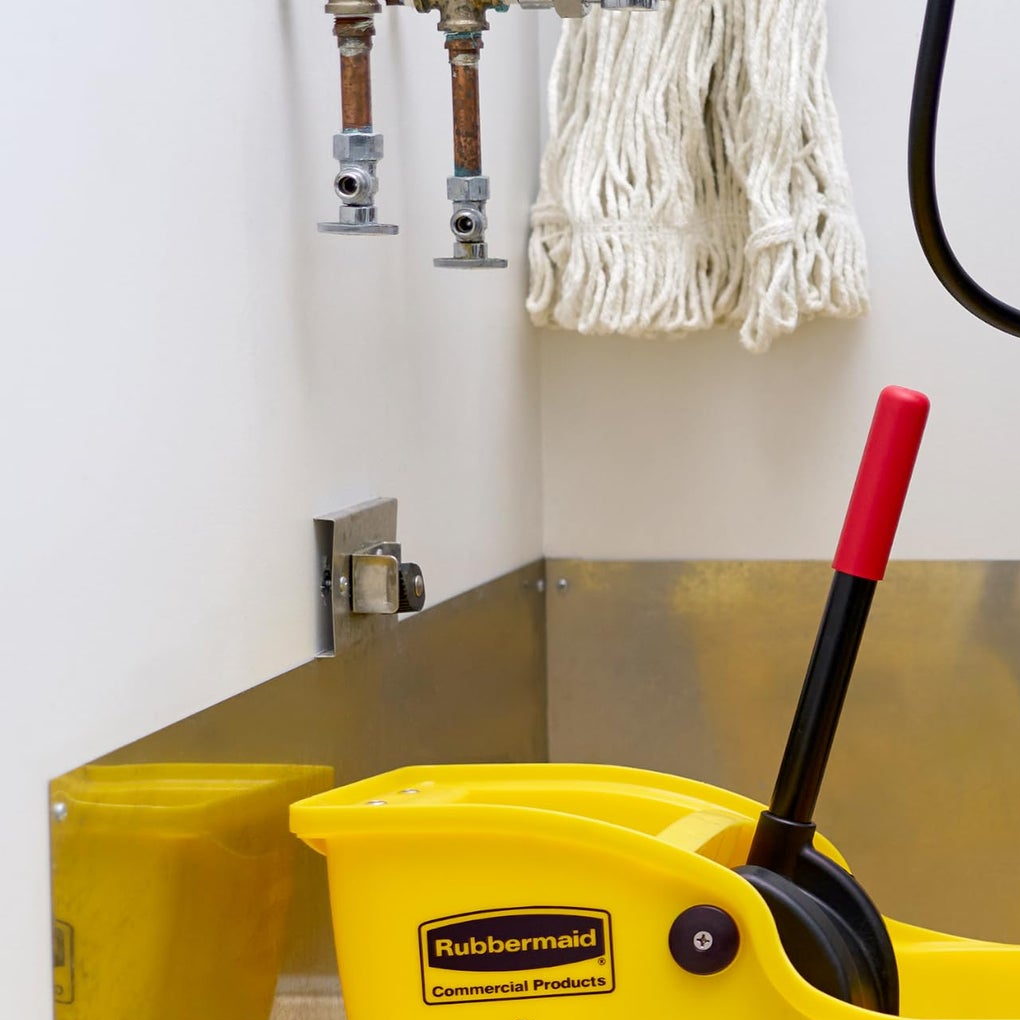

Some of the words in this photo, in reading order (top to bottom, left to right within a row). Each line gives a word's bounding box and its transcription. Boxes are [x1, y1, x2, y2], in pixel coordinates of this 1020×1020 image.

[435, 928, 597, 957] Rubbermaid
[432, 980, 529, 998] Commercial
[533, 976, 606, 991] Products
